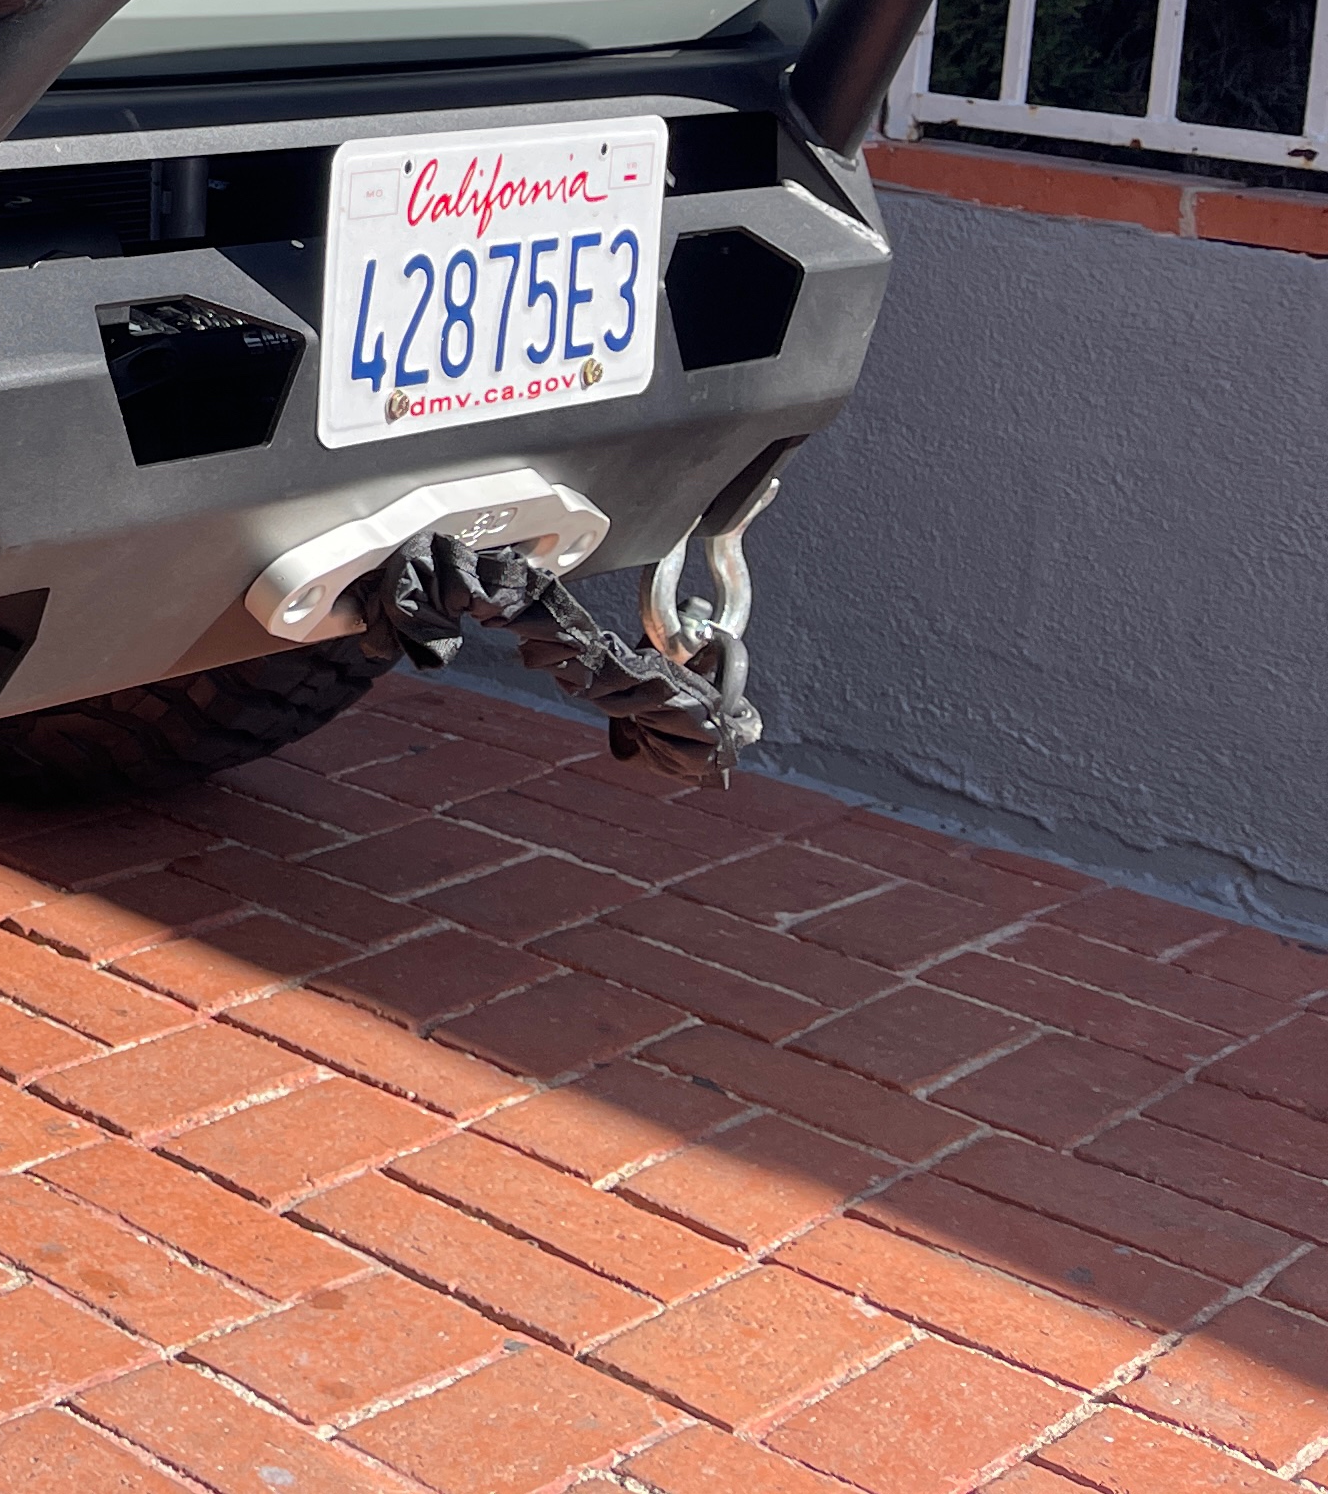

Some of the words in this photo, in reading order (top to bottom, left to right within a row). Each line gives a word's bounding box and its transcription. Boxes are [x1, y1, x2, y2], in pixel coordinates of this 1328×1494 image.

[365, 188, 384, 199] MO
[407, 152, 608, 238] California
[350, 227, 640, 393] 42875E3
[409, 371, 577, 418] dmv.ca.gov
